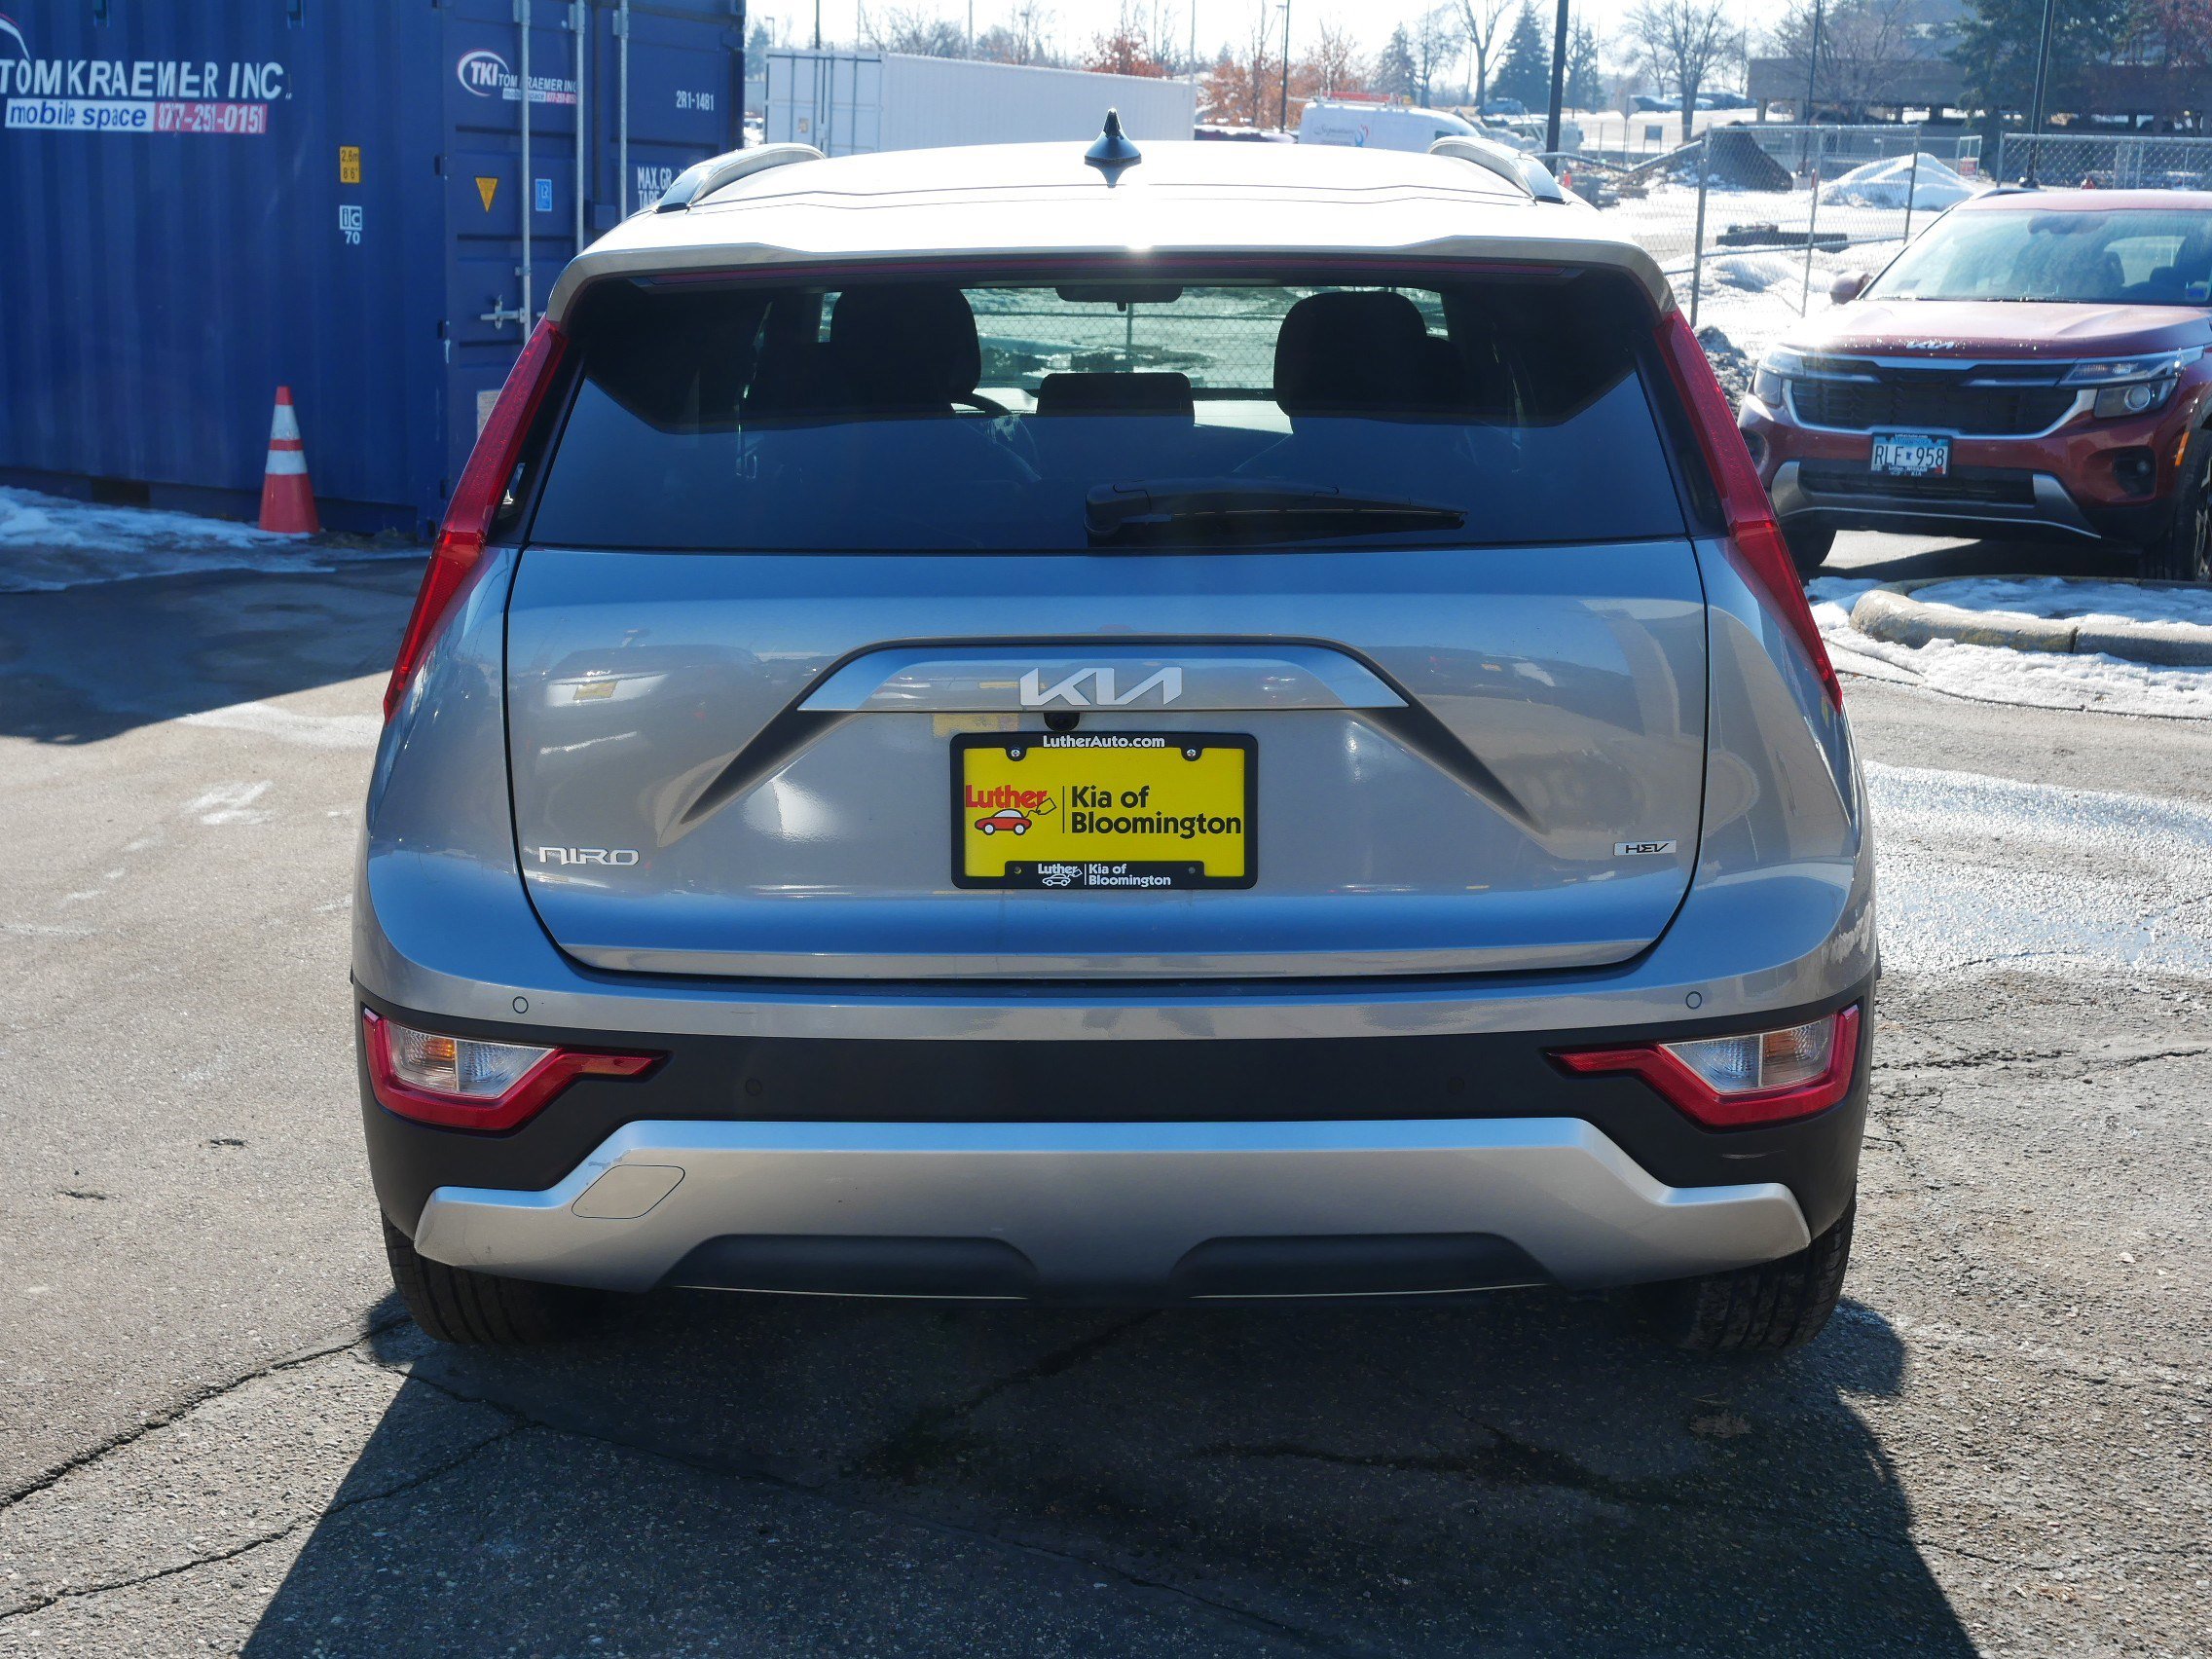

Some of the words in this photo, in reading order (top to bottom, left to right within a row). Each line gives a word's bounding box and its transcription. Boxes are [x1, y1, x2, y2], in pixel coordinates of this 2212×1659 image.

[0, 58, 62, 95] TOM
[67, 59, 218, 97] KRAEMER
[470, 60, 498, 87] TKI
[498, 73, 518, 88] TOM
[519, 76, 563, 92] RAEMER
[676, 90, 714, 111] 2R1-1481
[10, 101, 75, 126] mobile
[82, 107, 147, 129] space
[345, 231, 360, 244] 70
[1874, 445, 1904, 466] RLF
[1916, 447, 1945, 466] 958
[1019, 666, 1182, 706] KIA
[1043, 735, 1165, 748] LutherAuto.com
[965, 785, 1048, 808] Luther
[1072, 785, 1112, 808] Kia
[1121, 786, 1150, 808] of
[1071, 811, 1241, 839] Bloomington
[1625, 842, 1670, 854] HEV
[1038, 864, 1078, 874] Luther
[1088, 864, 1109, 874] Kia
[1112, 864, 1126, 874] of
[1088, 874, 1171, 888] Bloomington
